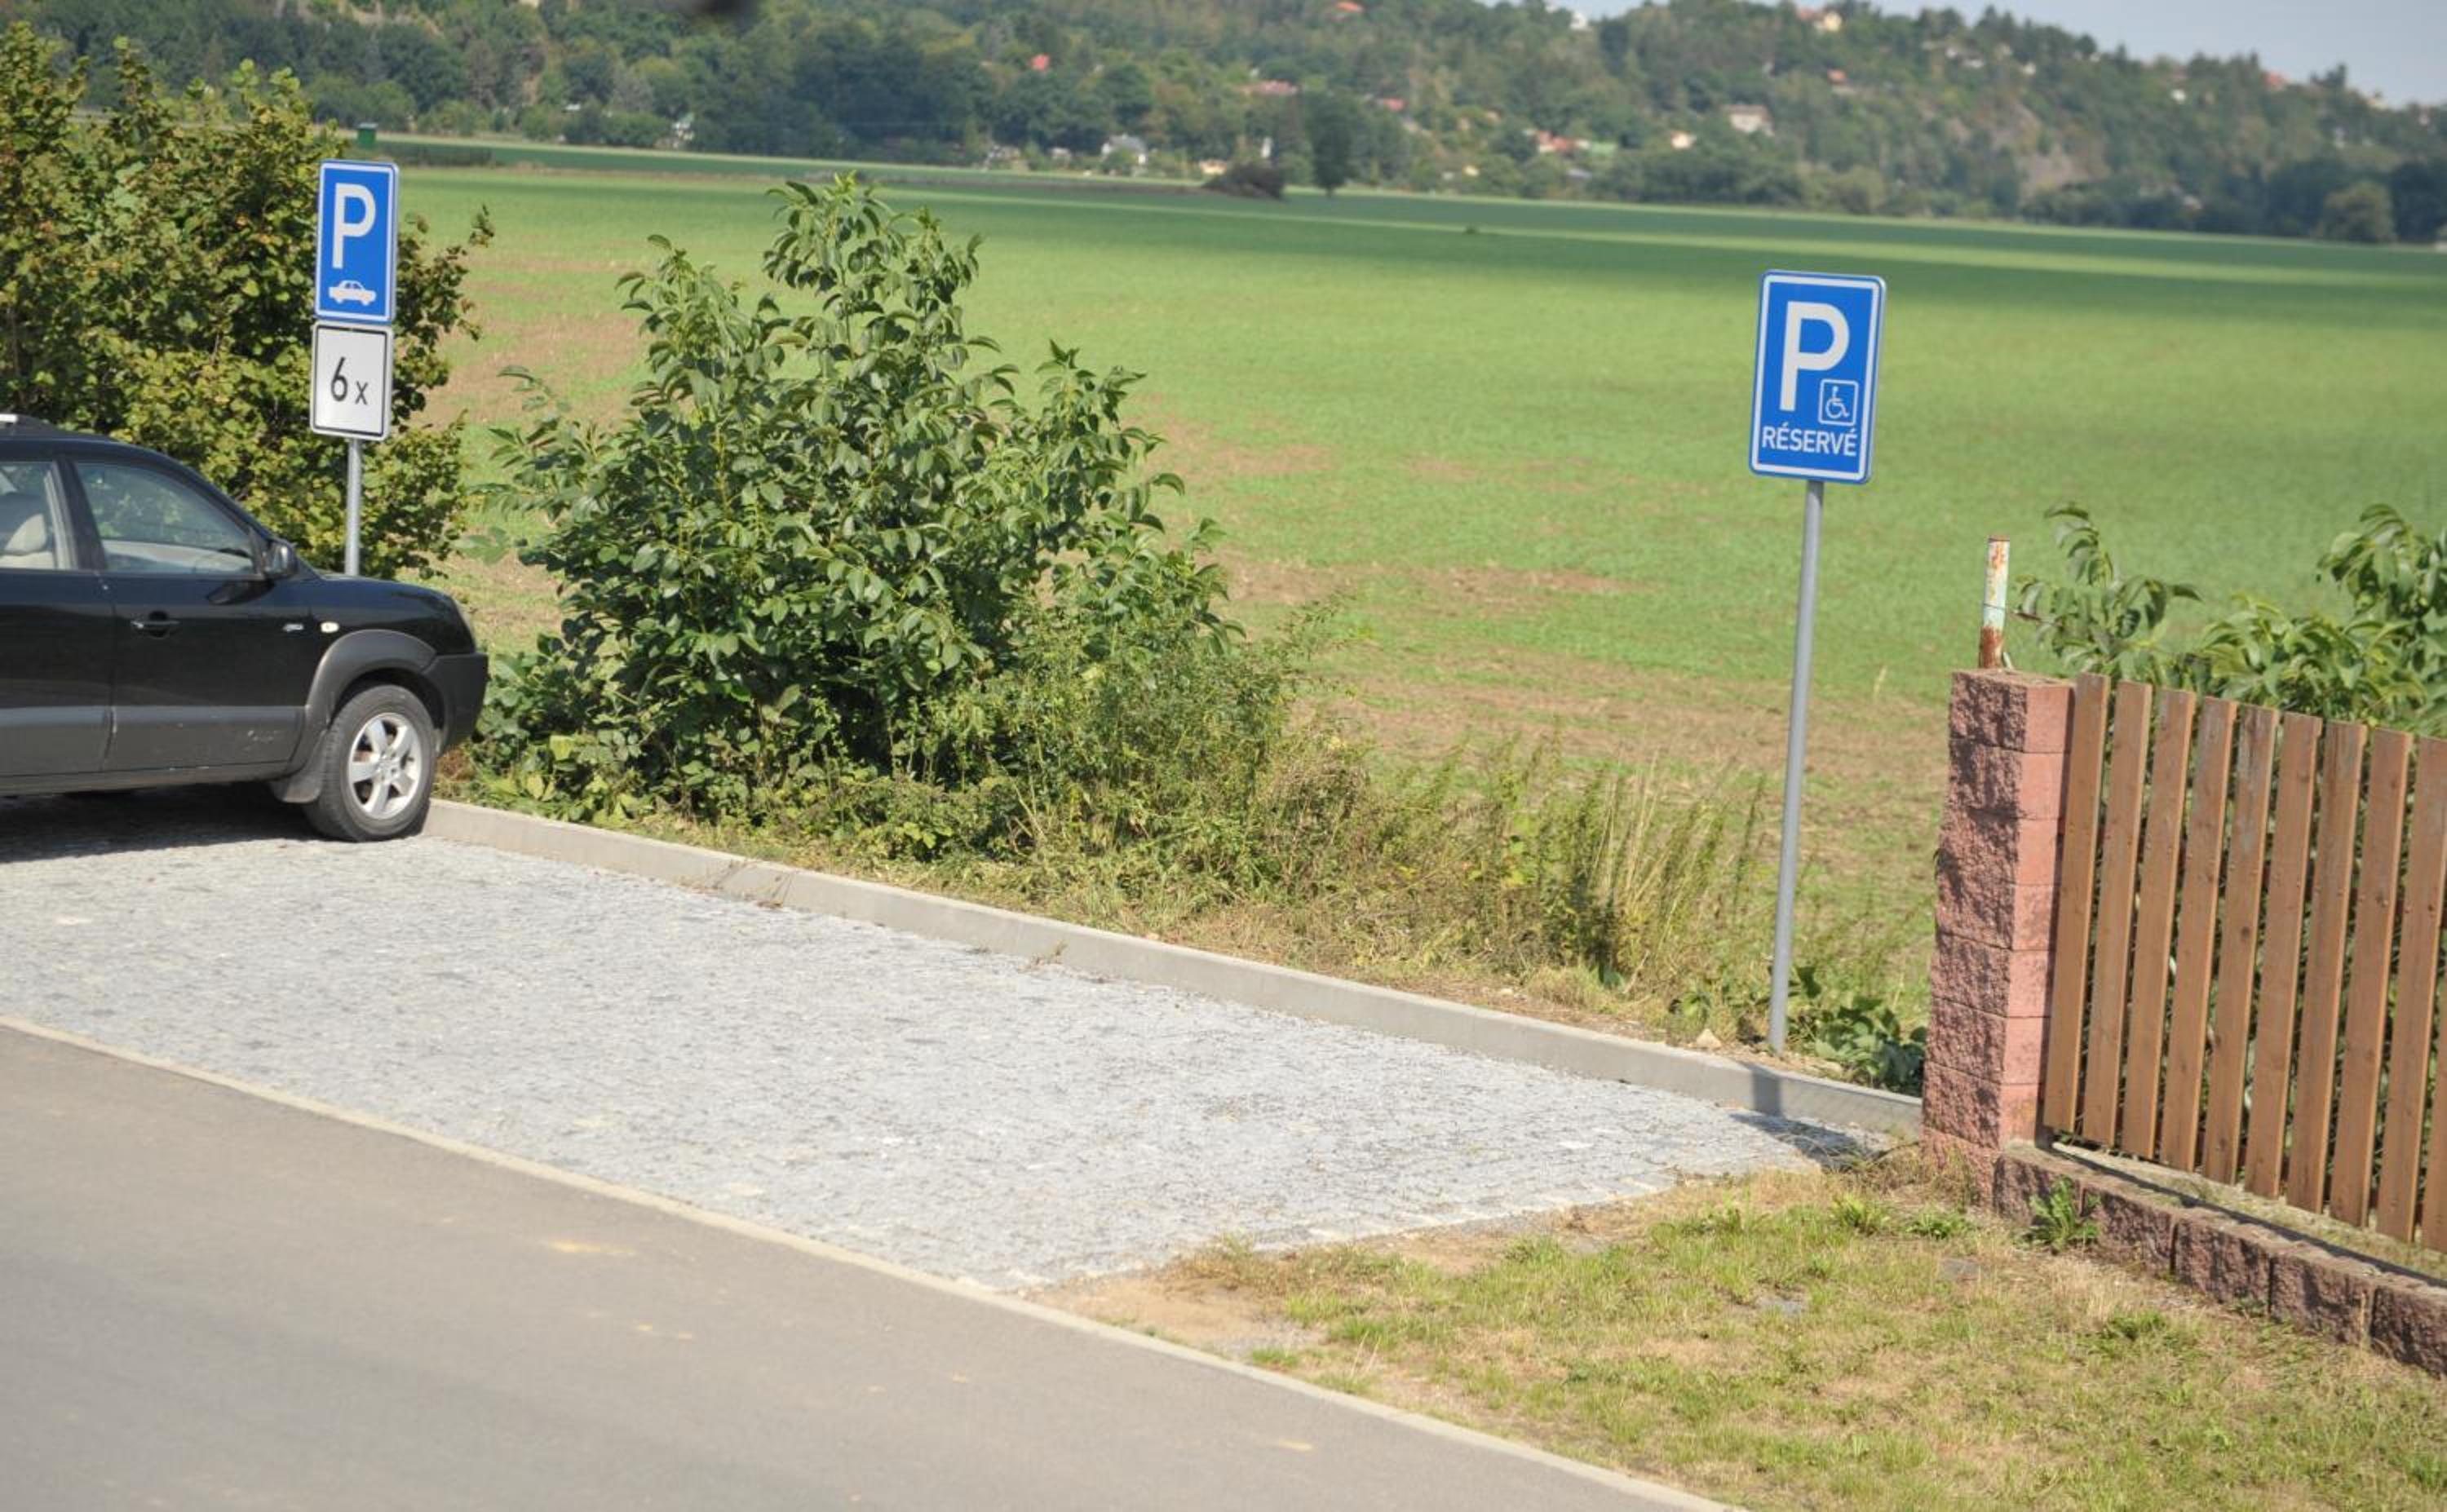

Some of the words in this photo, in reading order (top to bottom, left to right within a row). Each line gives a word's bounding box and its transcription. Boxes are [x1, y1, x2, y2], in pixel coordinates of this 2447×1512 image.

[332, 183, 376, 269] P
[1779, 301, 1849, 411] P
[1762, 422, 1856, 457] RÉSERVÉ
